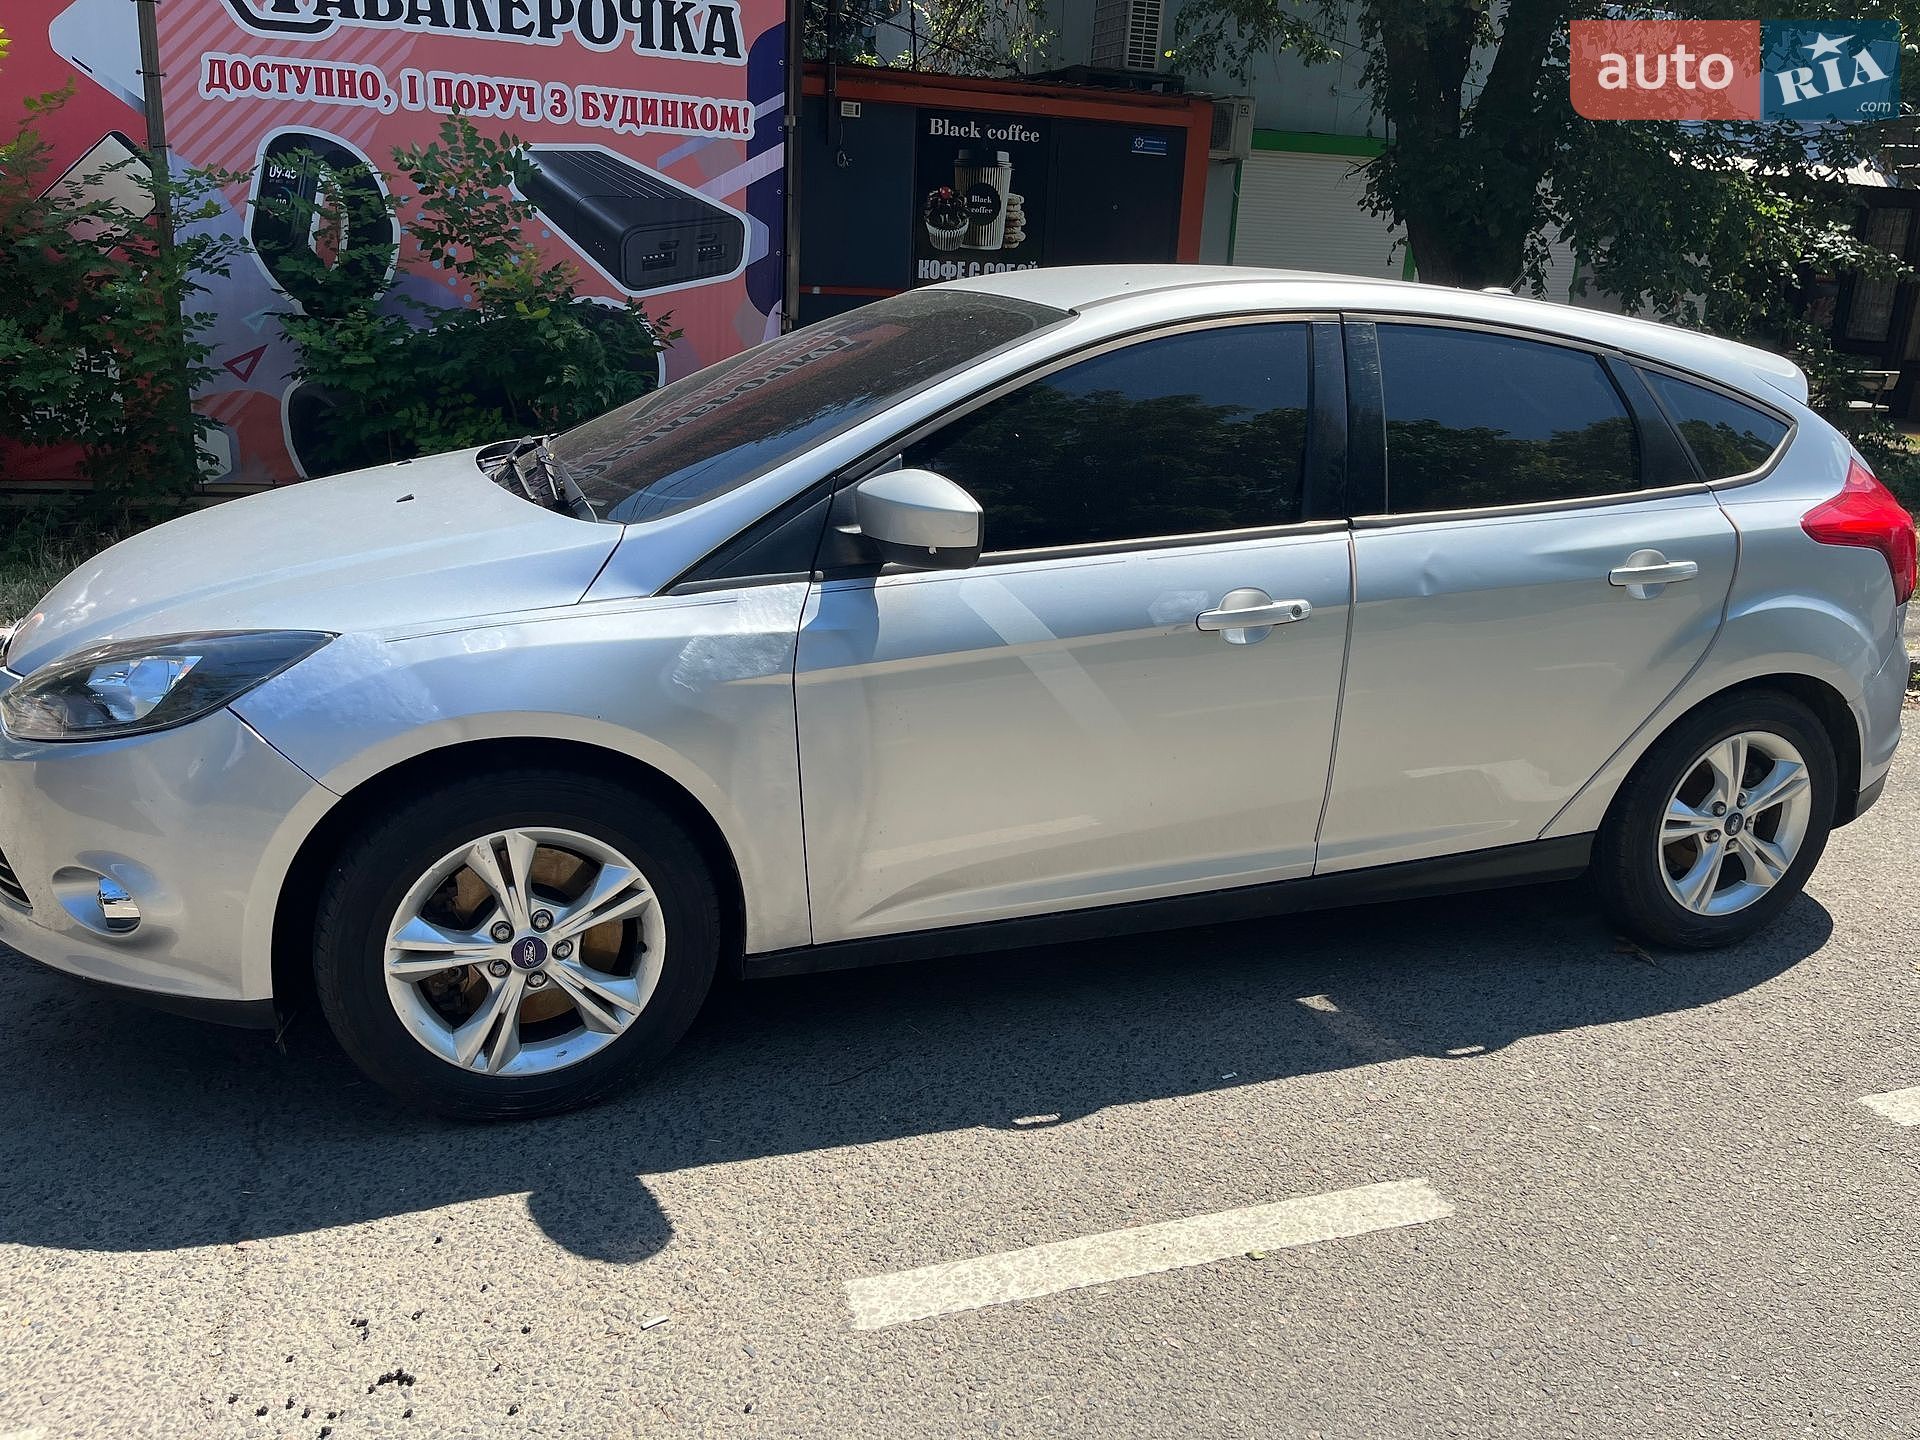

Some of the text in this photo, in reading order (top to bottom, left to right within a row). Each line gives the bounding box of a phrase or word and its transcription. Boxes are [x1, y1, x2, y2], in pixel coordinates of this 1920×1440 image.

[229, 0, 742, 58] АКЕРОЧКА
[205, 58, 750, 134] ДОСТУПНО, І ПОРУЧ З БУДИНКОМ!
[929, 118, 1040, 142] Black coffee
[971, 195, 992, 203] Black
[971, 206, 993, 214] coffee
[918, 259, 965, 280] КОФЕ
